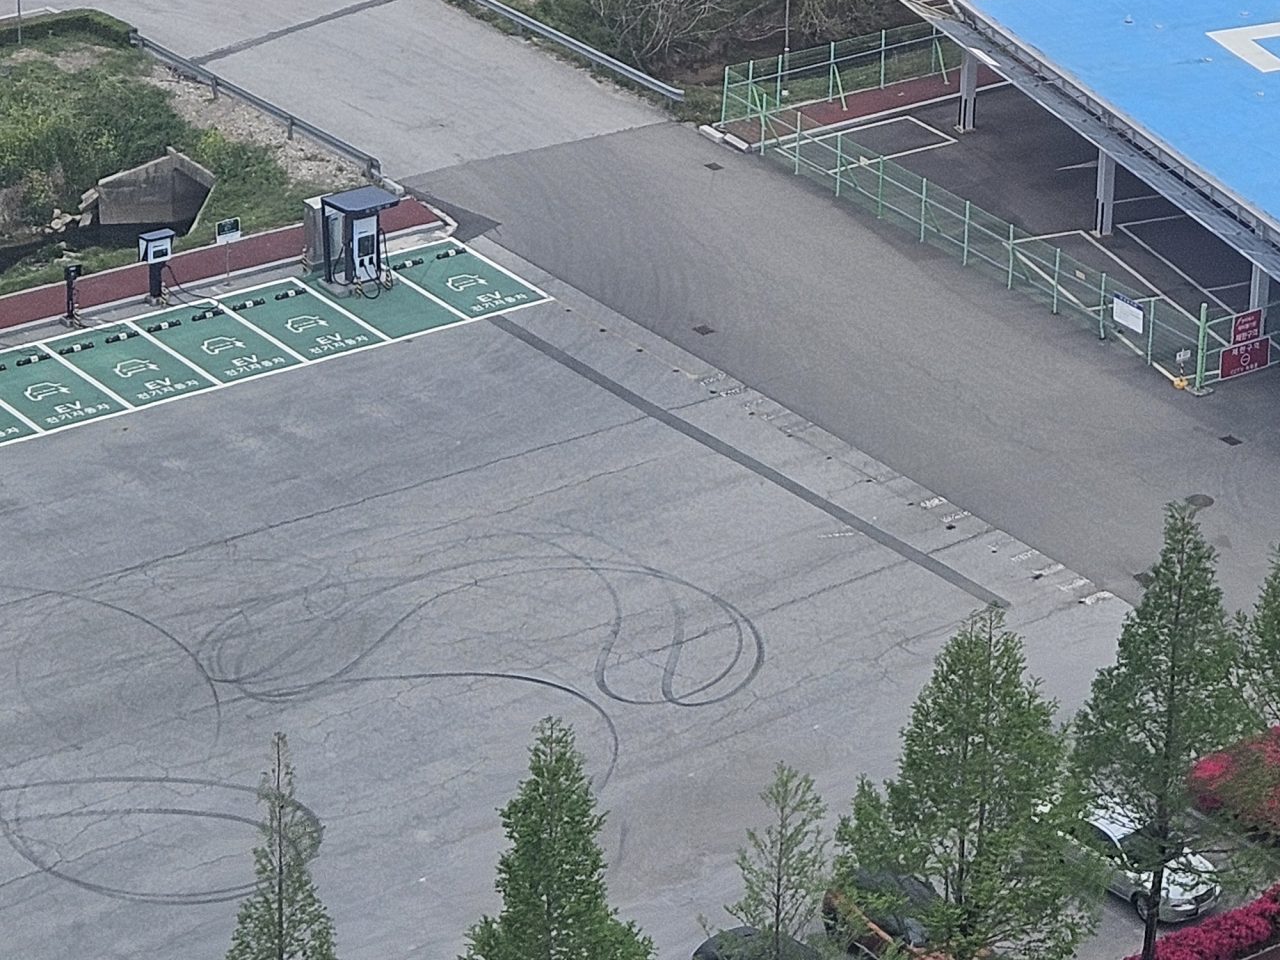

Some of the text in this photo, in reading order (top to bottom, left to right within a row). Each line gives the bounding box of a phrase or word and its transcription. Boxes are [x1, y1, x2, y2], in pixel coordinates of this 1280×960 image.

[470, 293, 528, 312] 전기자동차
[476, 290, 502, 303] EV
[309, 335, 368, 354] 전기자동차
[316, 332, 342, 345] EV
[224, 356, 286, 376] 전기자동차
[232, 354, 258, 367] EV
[136, 379, 199, 400] 전기자동차
[144, 377, 171, 390] EV
[45, 403, 110, 424] 전기자동차
[54, 400, 82, 414] EV
